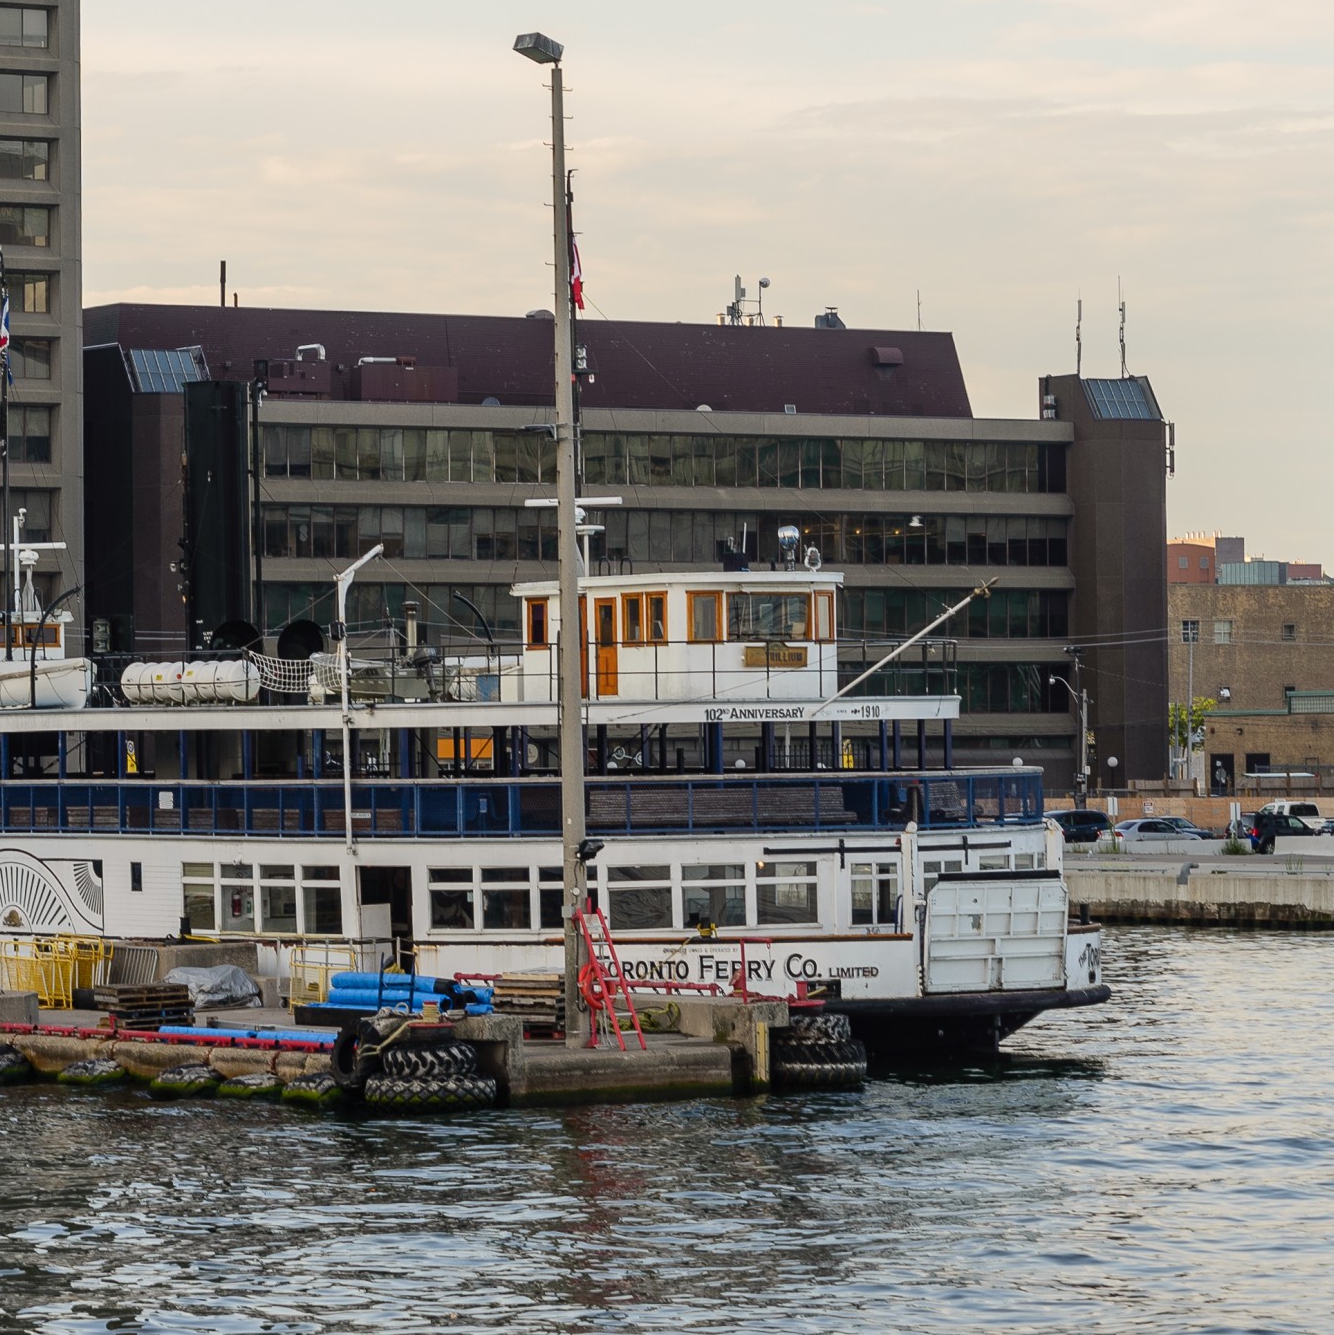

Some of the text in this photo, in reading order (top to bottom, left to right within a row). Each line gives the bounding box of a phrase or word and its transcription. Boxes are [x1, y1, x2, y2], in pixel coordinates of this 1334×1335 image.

[769, 651, 803, 662] RILLIUM
[729, 707, 805, 719] ANNIVERSARY
[861, 706, 880, 718] 1910
[829, 967, 879, 978] LIMITED
